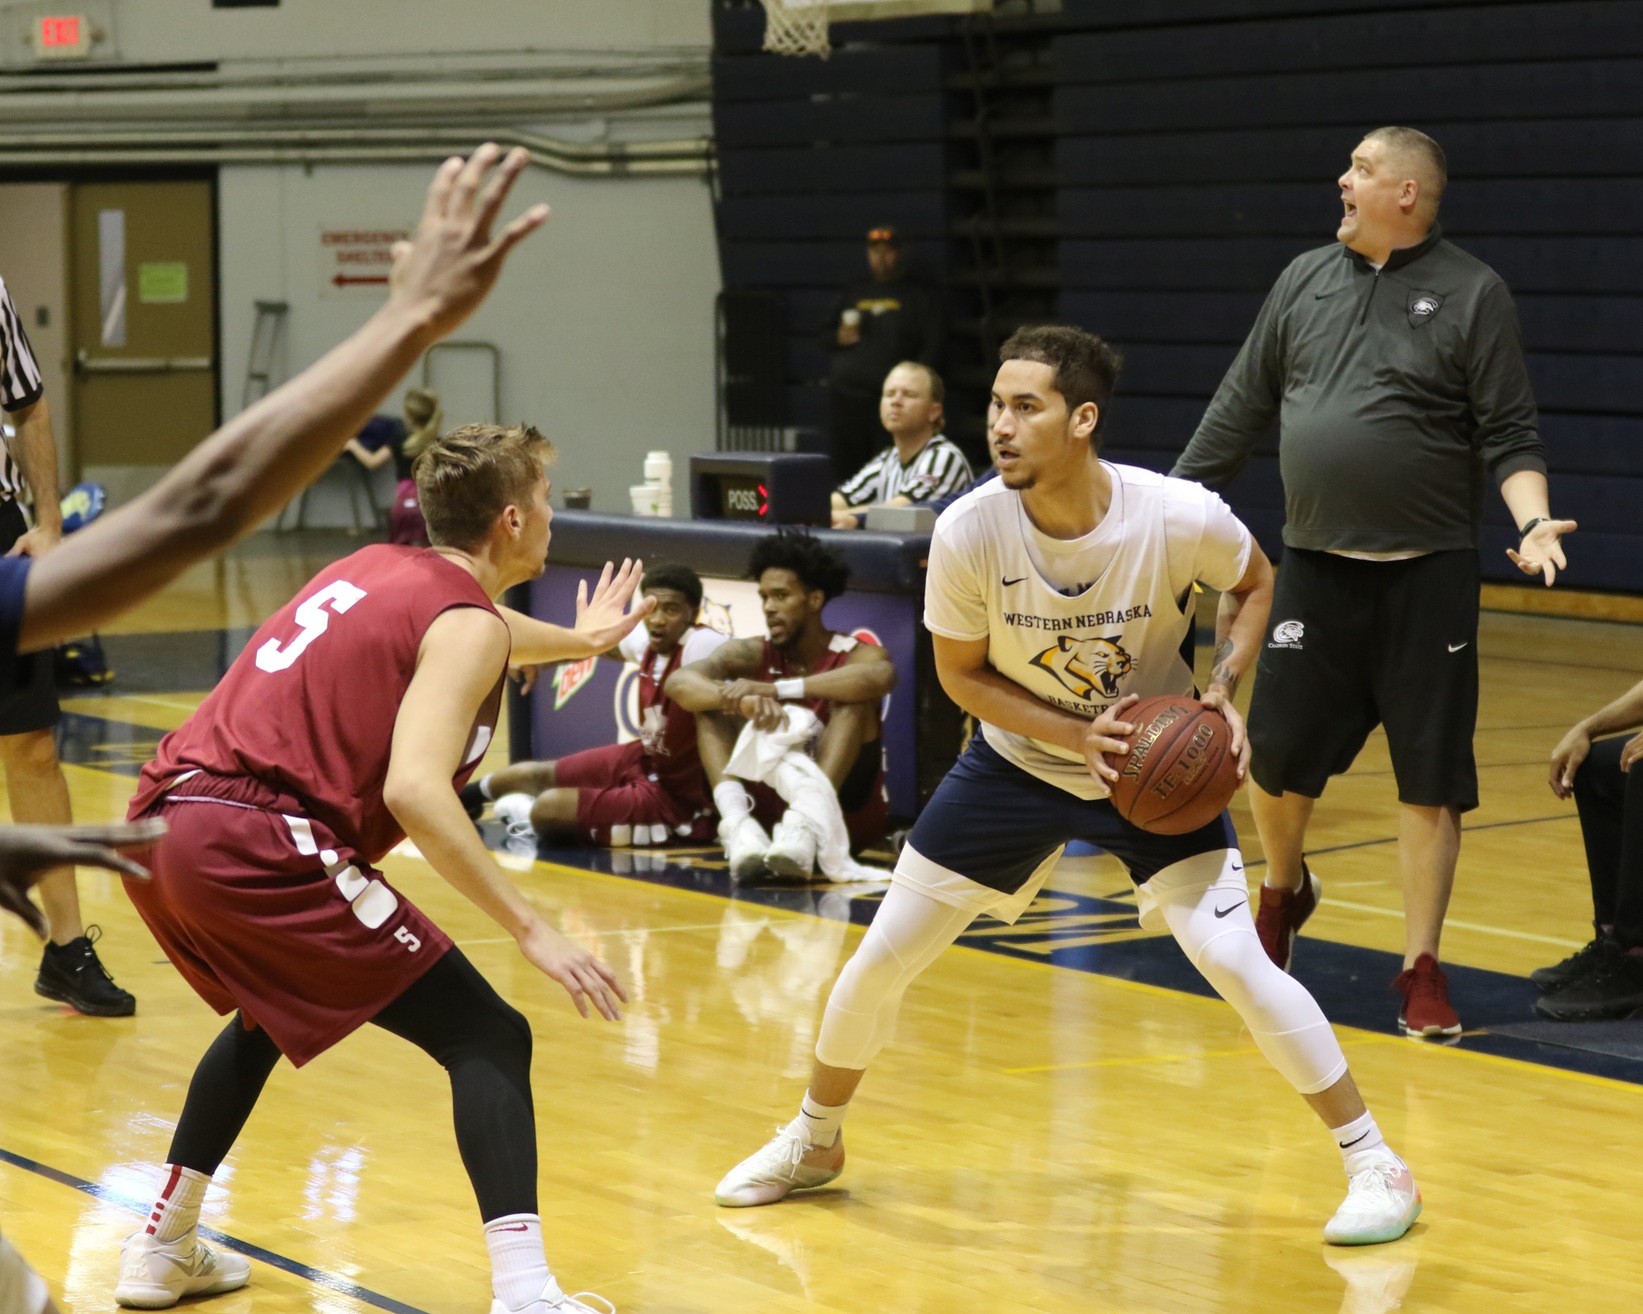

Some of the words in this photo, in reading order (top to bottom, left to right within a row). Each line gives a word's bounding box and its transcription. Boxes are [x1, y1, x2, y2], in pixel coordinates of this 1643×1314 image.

[42, 16, 79, 47] EXIT
[728, 490, 759, 510] POSS.
[255, 579, 368, 673] 5
[1003, 612, 1073, 631] WESTERN
[1076, 604, 1152, 628] NEBRASKA
[1122, 703, 1189, 784] SPALDING
[393, 925, 422, 953] 5
